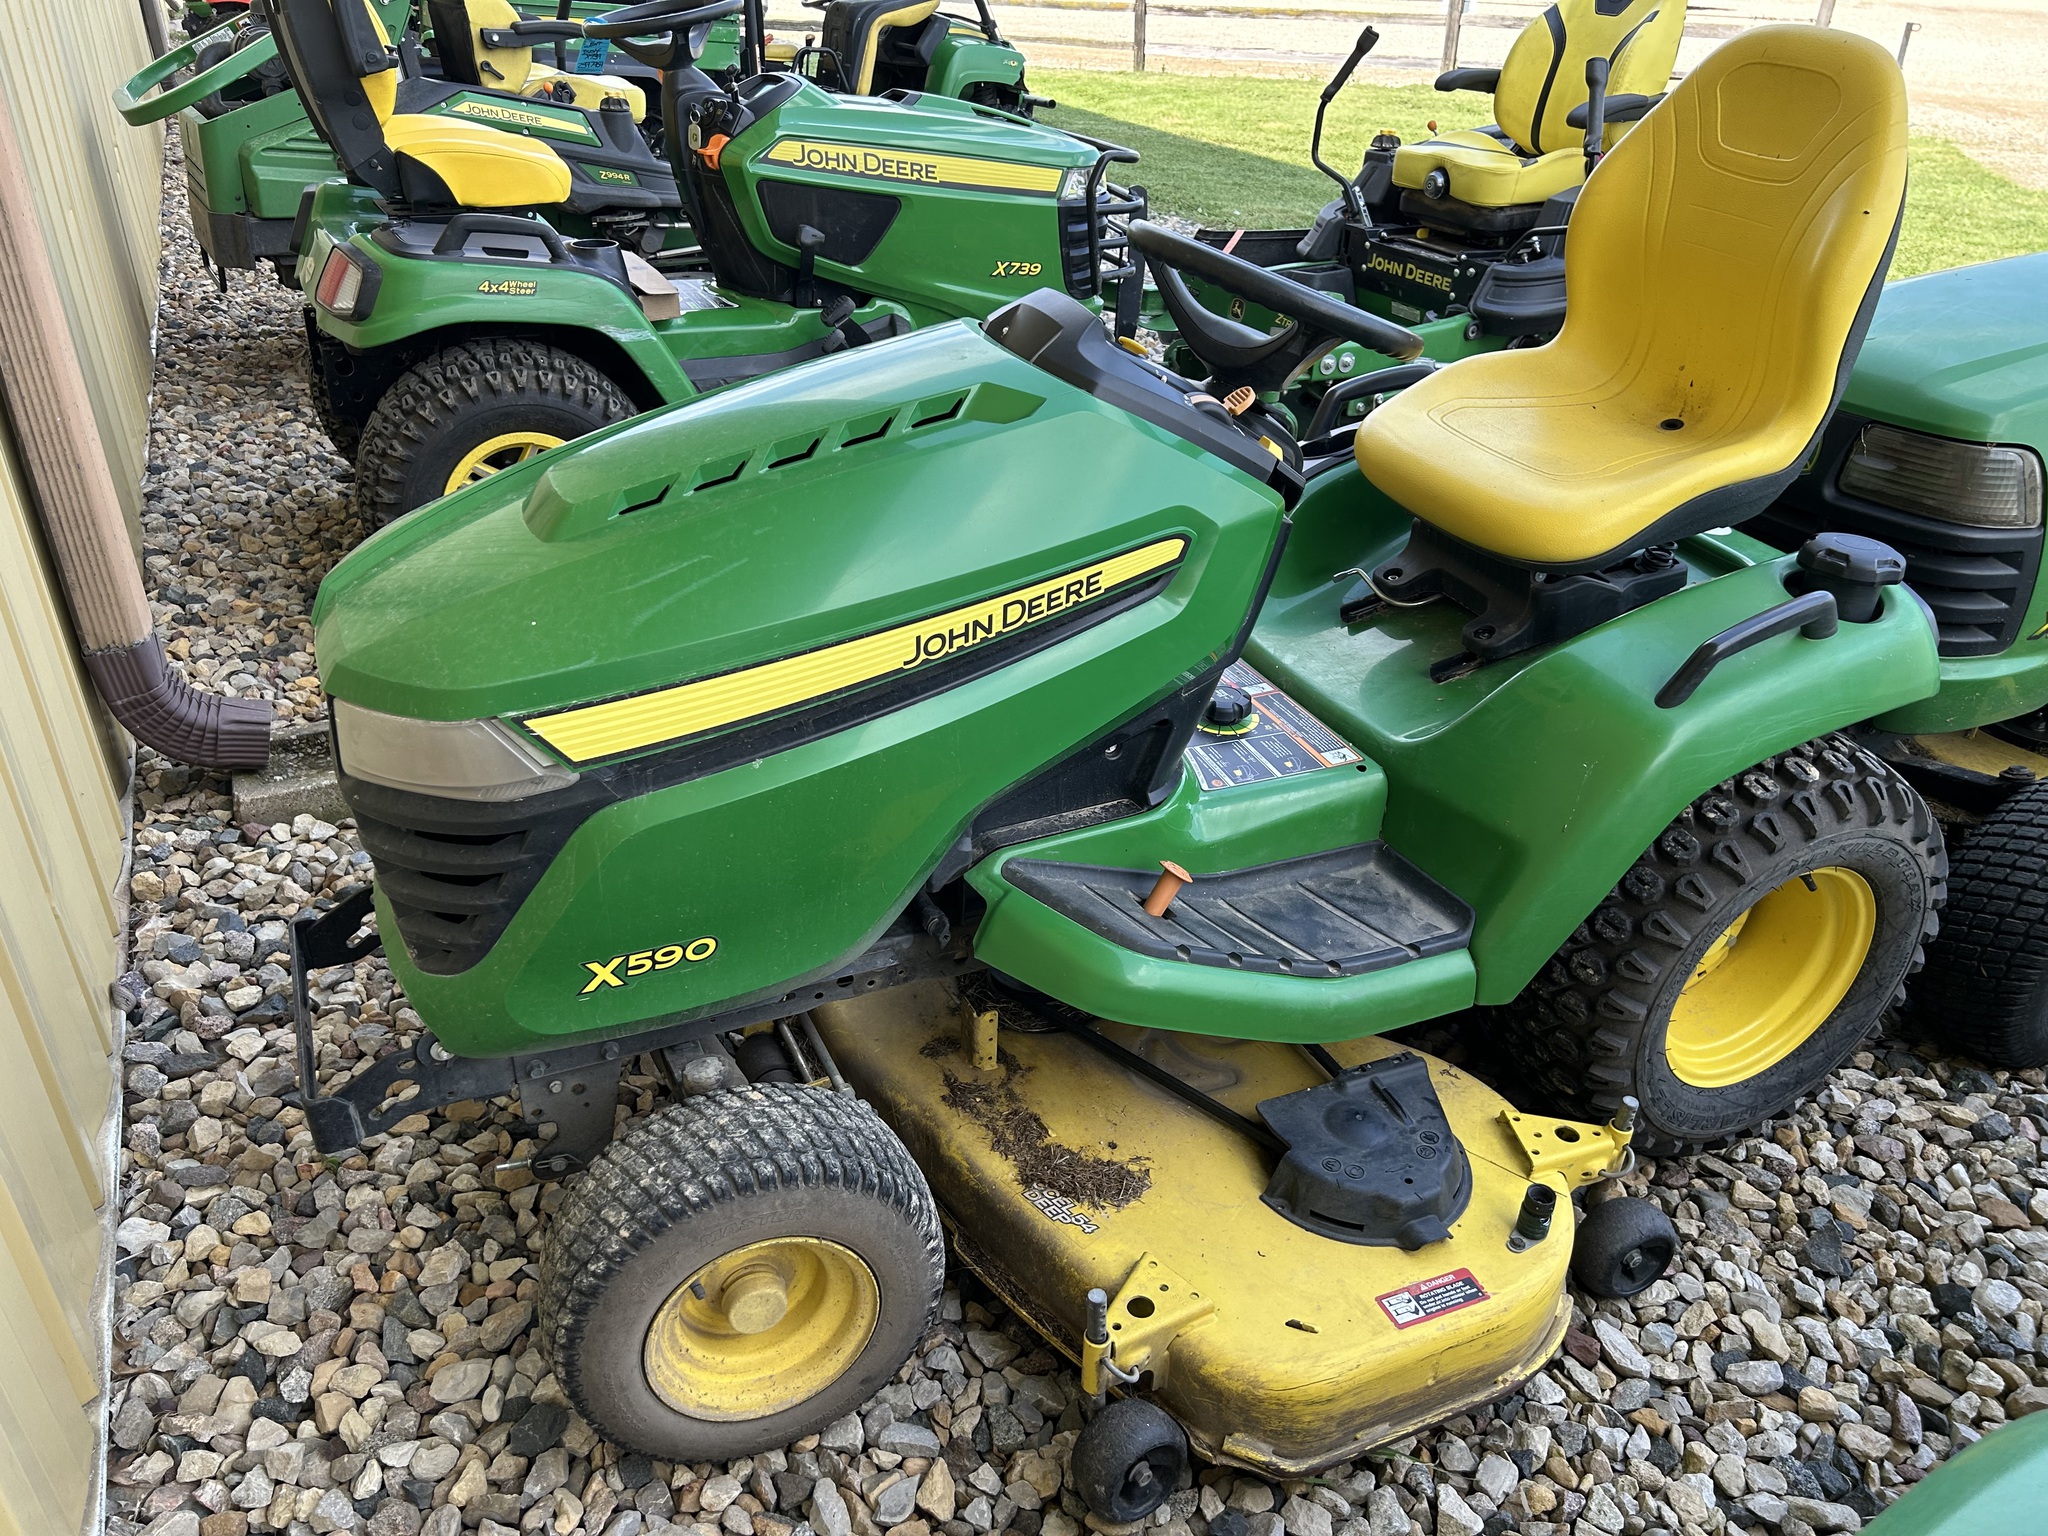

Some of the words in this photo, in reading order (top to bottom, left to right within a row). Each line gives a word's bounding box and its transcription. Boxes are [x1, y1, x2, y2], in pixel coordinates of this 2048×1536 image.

[465, 103, 499, 120] JOHN
[501, 107, 543, 126] DEERE
[793, 144, 858, 170] JOHN
[863, 152, 938, 181] DEERE
[599, 170, 631, 181] Z994R
[990, 260, 1043, 277] X739
[1367, 253, 1403, 277] JOHN
[1404, 262, 1452, 292] DEERE
[478, 280, 509, 294] 4x4
[509, 280, 537, 288] Wheel
[509, 287, 537, 296] Steer
[903, 613, 994, 667] JOHN
[1002, 570, 1103, 630] DEERE
[576, 935, 719, 997] X590
[1020, 1189, 1072, 1225] DEEP
[1071, 1212, 1100, 1235] 54
[1426, 1274, 1455, 1287] DANGER
